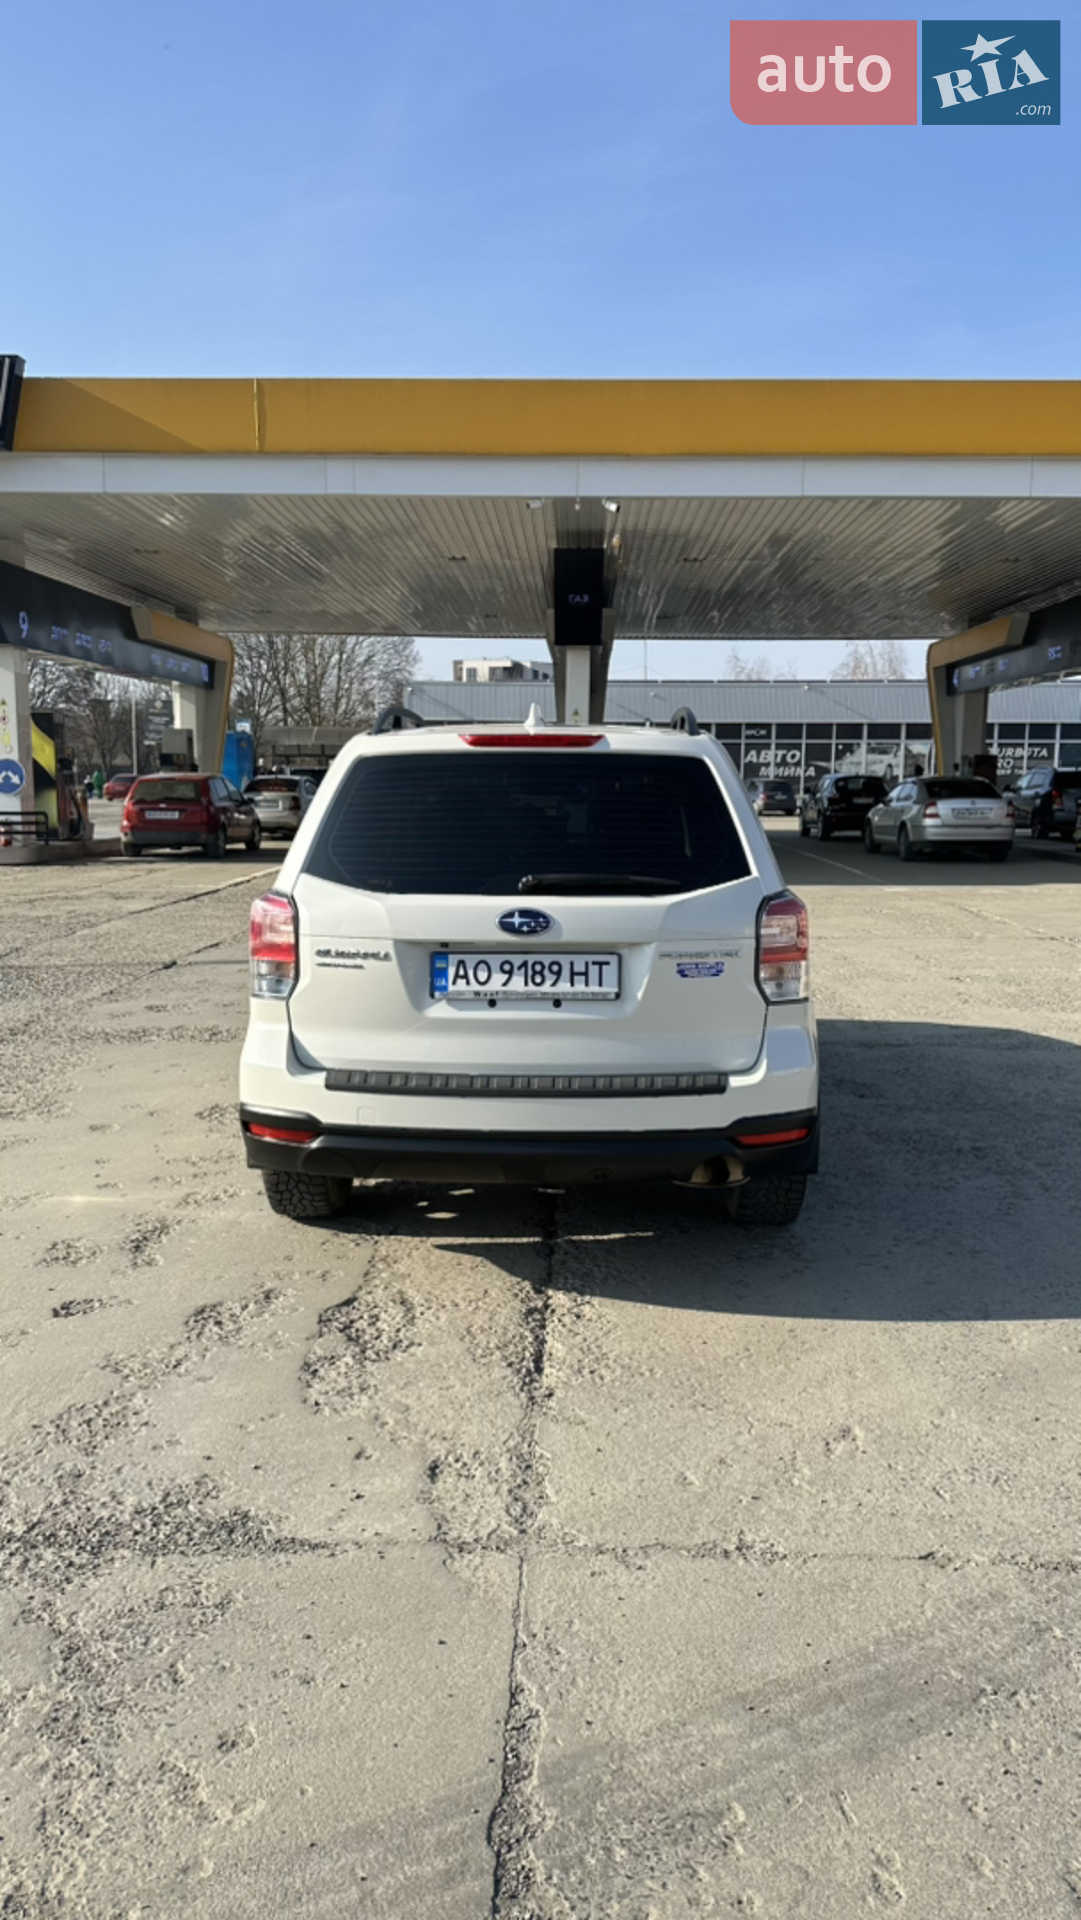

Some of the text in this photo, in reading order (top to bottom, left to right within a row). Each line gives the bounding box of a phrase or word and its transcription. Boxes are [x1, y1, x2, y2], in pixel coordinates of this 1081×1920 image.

[568, 593, 590, 603] ГАЗ
[19, 610, 29, 639] 9
[745, 749, 801, 763] АВТО
[499, 959, 563, 988] 9189
